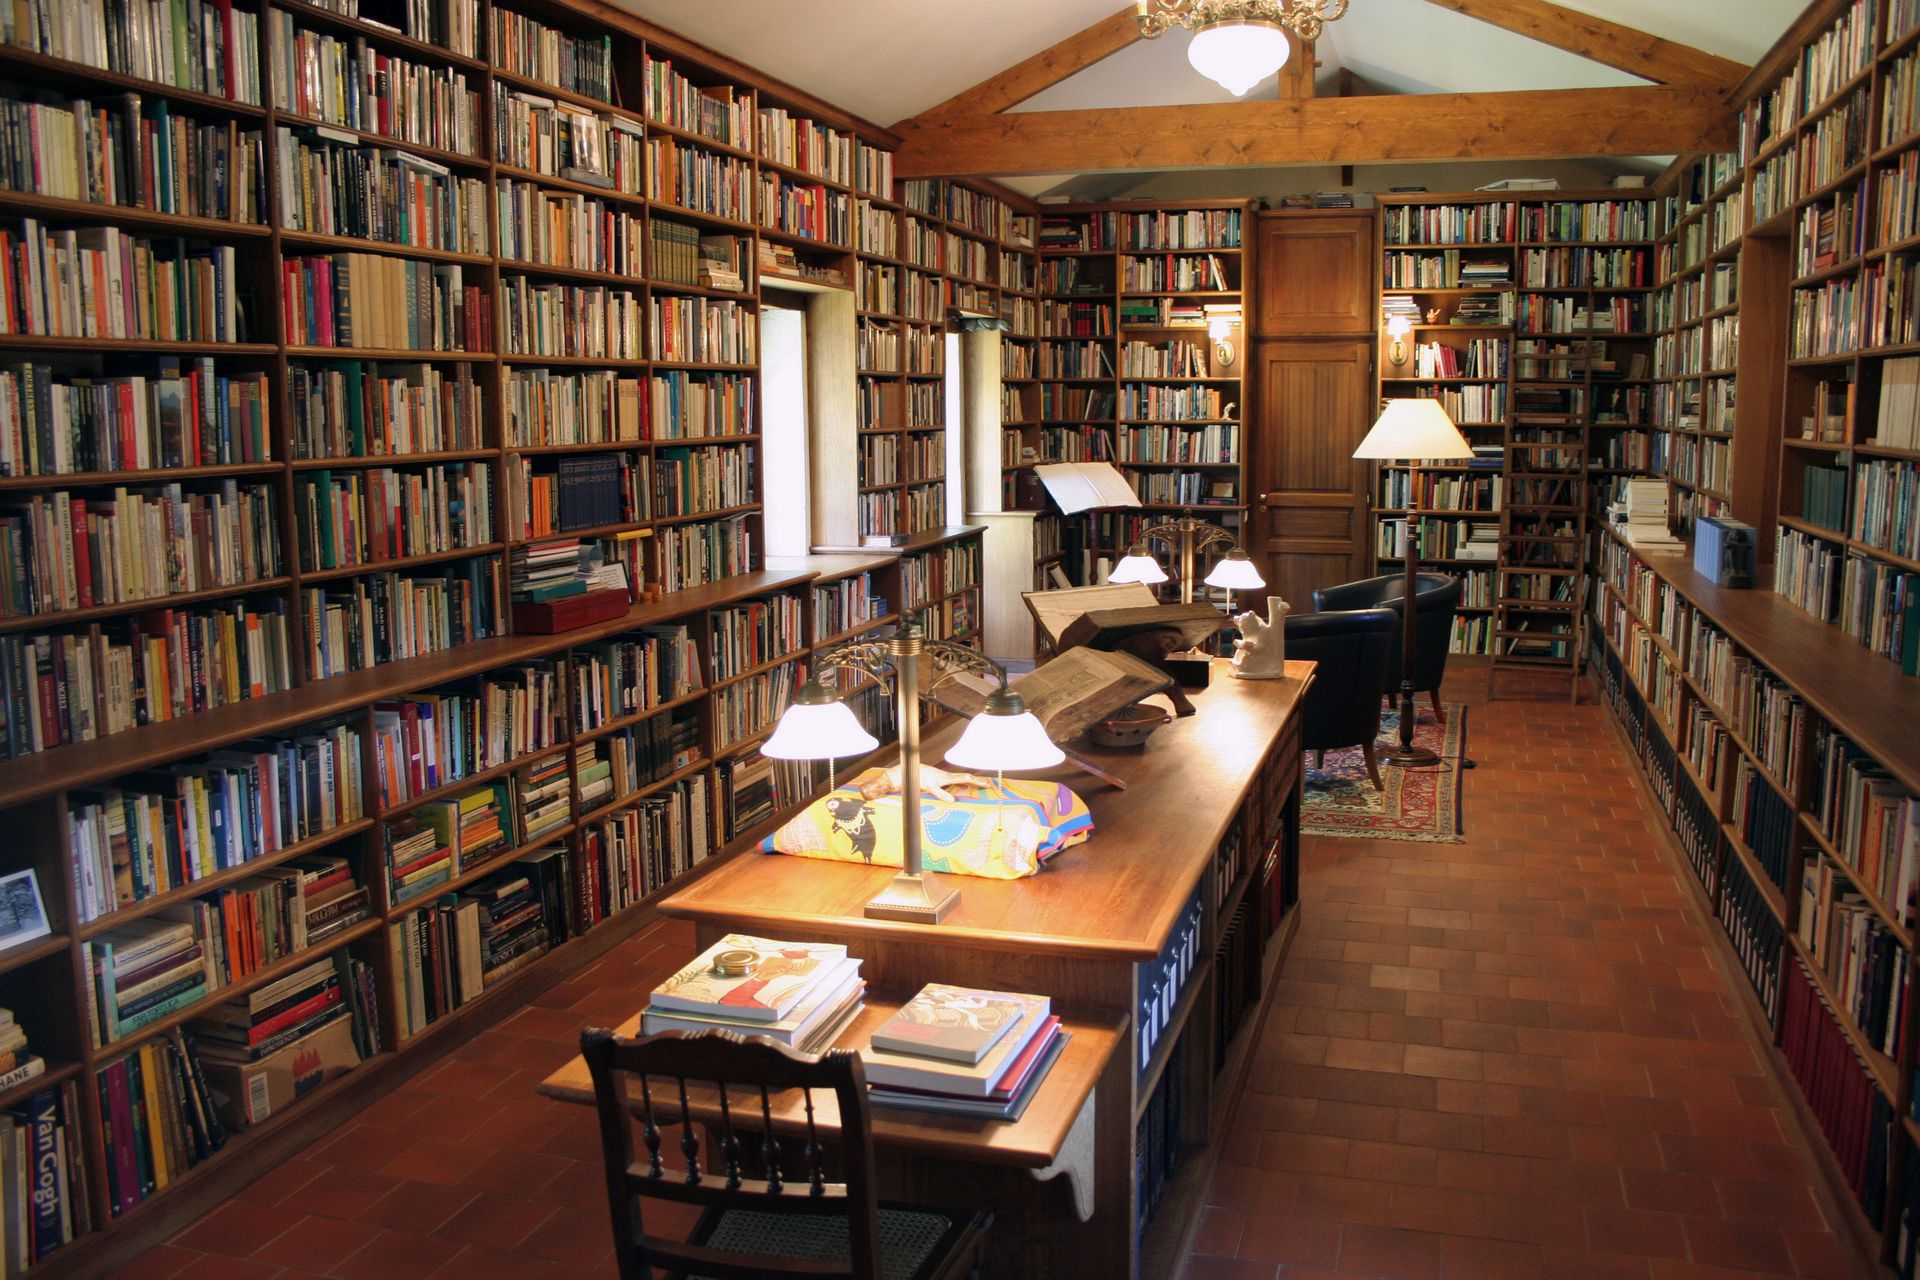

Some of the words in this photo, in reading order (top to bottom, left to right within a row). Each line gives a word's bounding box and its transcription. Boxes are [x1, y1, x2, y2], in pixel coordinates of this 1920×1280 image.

[25, 369, 34, 412] FORTRESS
[492, 947, 515, 966] VENICE
[38, 1104, 57, 1151] Van
[34, 1153, 59, 1217] Gogh
